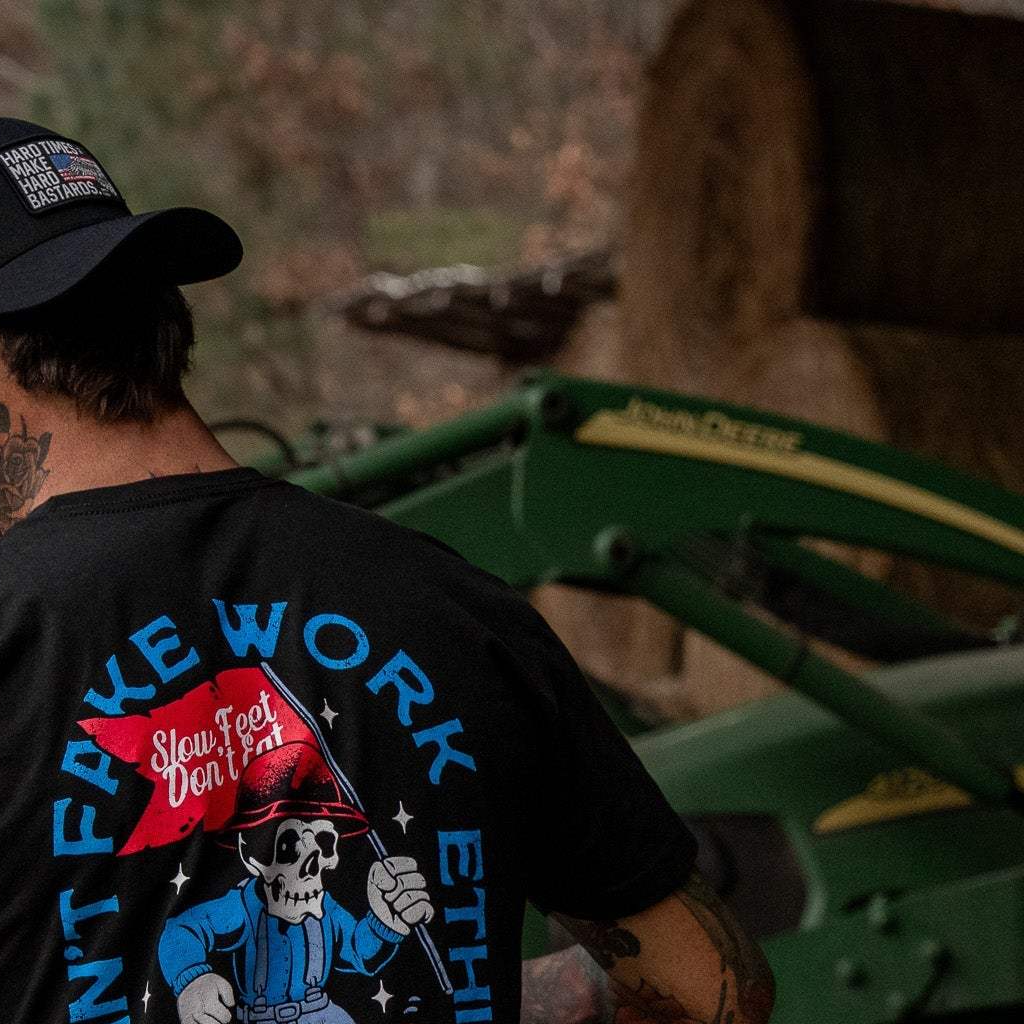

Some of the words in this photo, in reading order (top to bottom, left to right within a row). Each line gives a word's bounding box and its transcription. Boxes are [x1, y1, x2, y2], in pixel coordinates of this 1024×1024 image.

[0, 143, 42, 167] HARD
[9, 156, 52, 180] MAKE
[18, 171, 60, 195] HARD
[52, 613, 199, 857] FAKE
[212, 598, 477, 785] WORK
[150, 728, 216, 773] Slow
[214, 690, 277, 747] Feet
[162, 746, 239, 808] Don't
